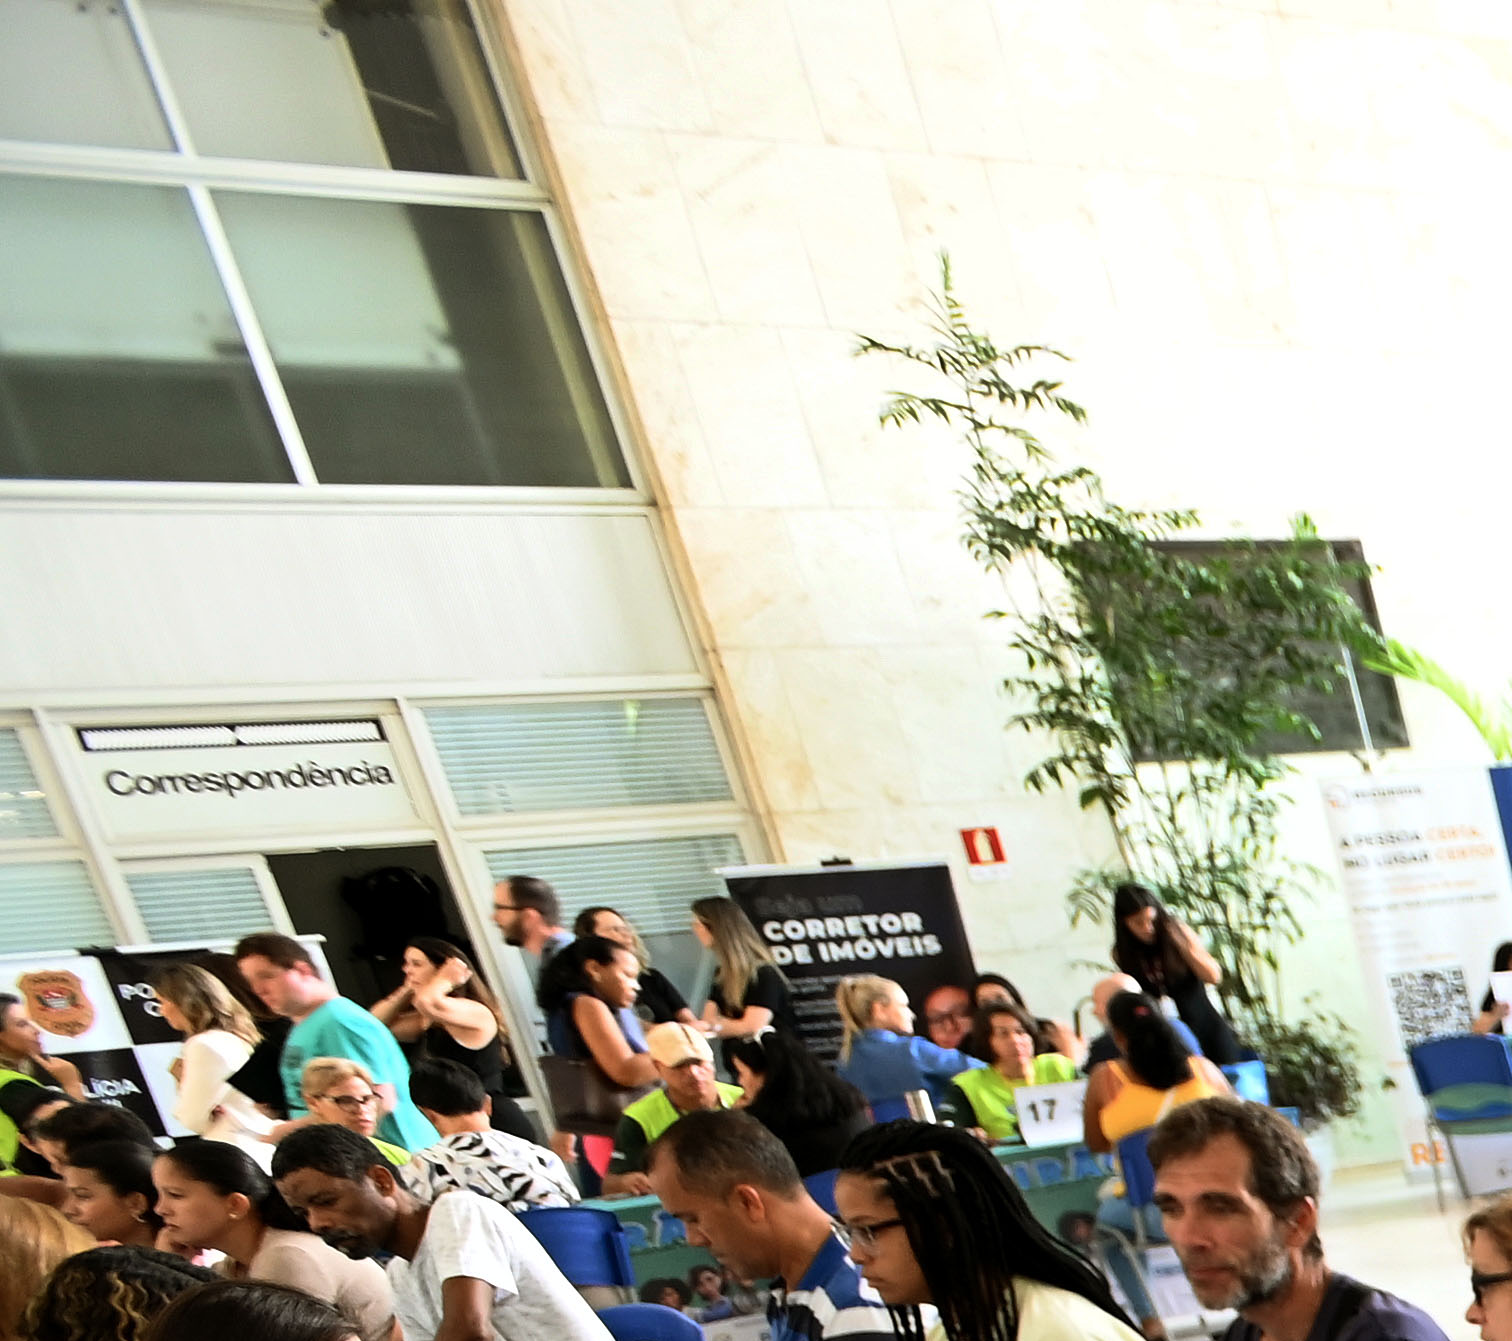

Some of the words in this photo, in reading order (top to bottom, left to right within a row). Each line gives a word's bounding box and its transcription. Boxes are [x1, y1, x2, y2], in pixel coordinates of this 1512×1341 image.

[105, 760, 394, 798] Correspondência
[763, 912, 924, 942] CORRETOR
[773, 944, 814, 966] DE
[818, 934, 943, 964] IMÓVEIS
[1026, 1099, 1057, 1123] 17
